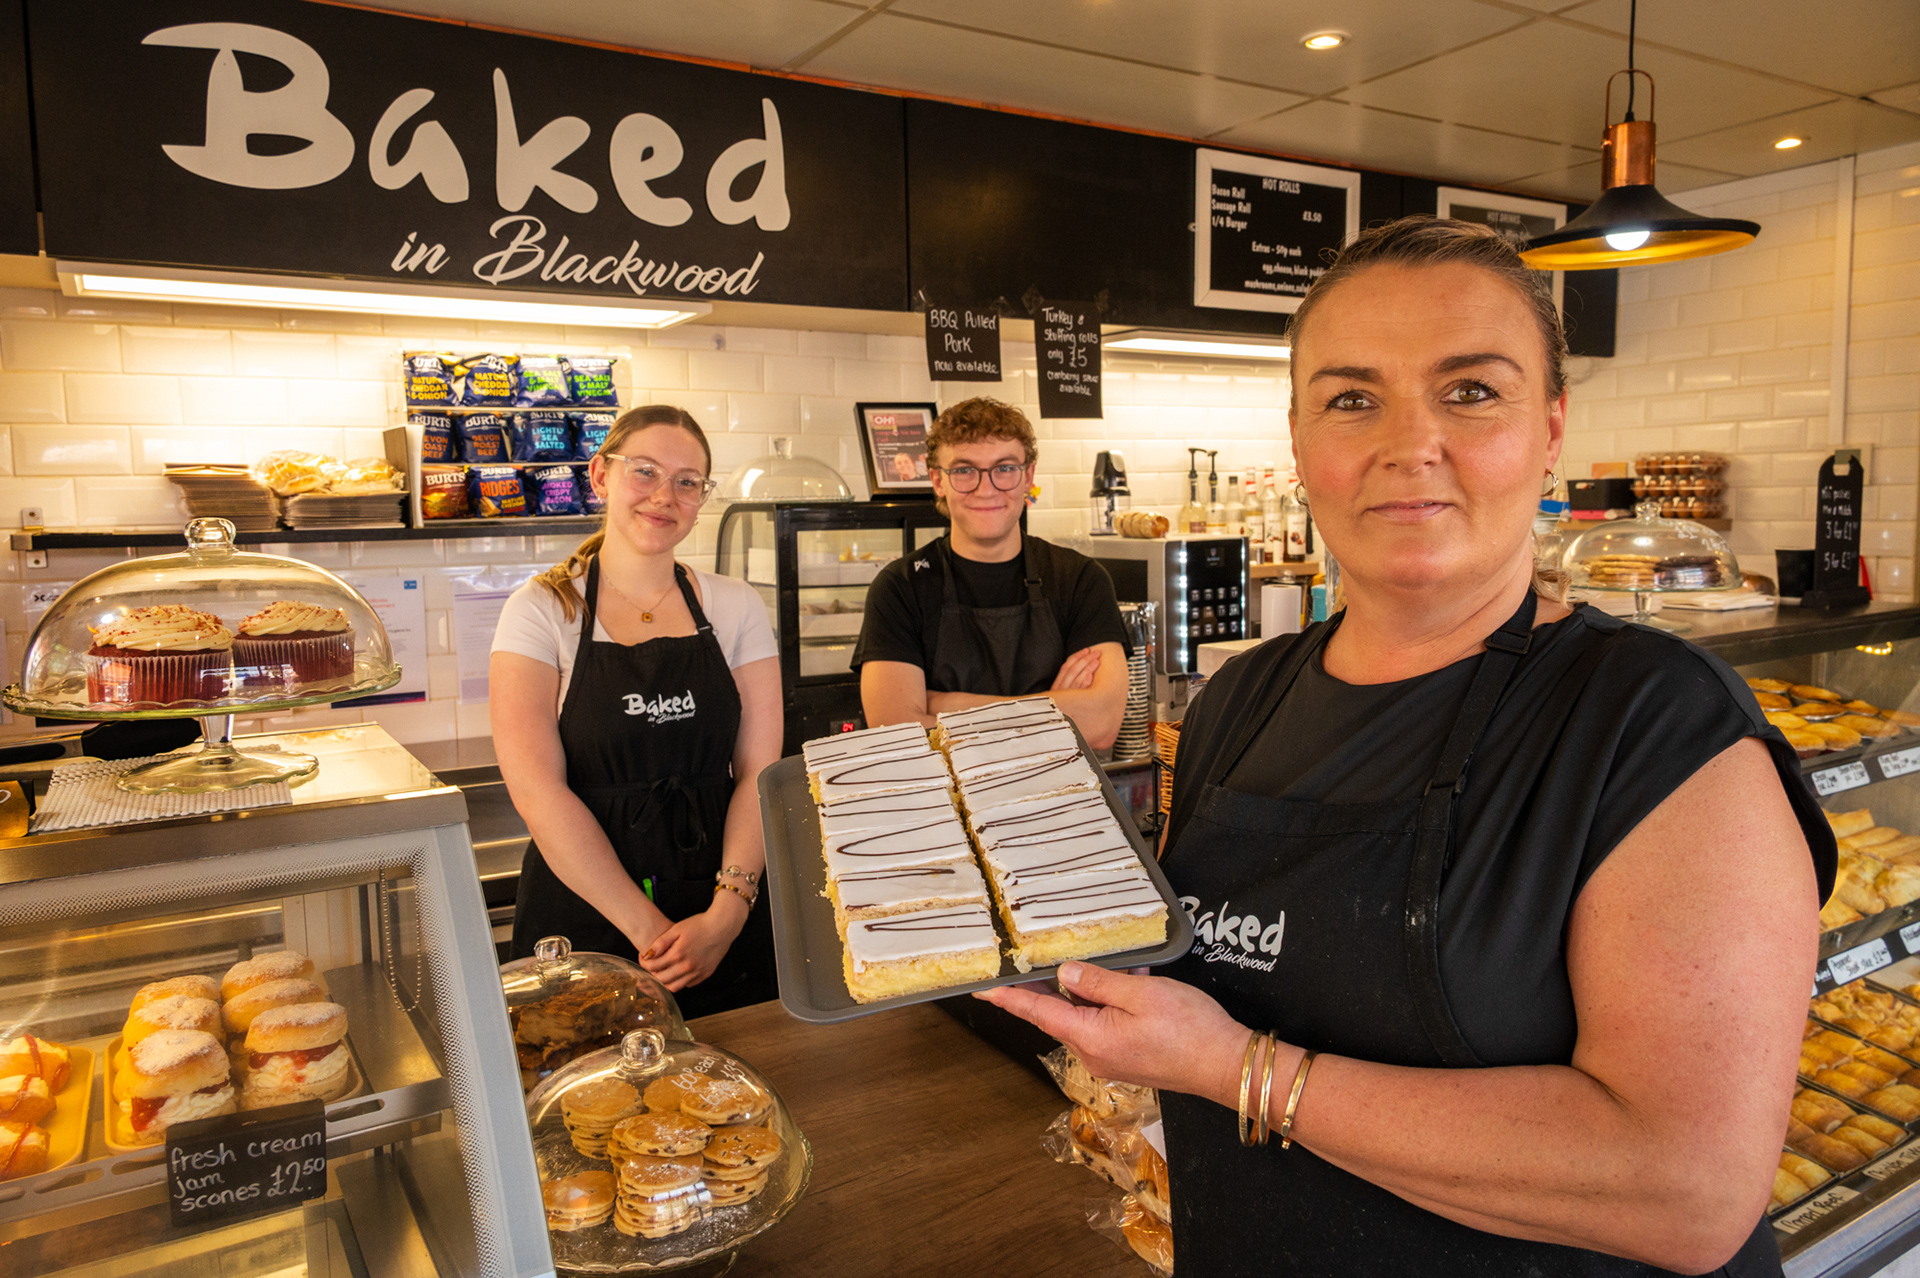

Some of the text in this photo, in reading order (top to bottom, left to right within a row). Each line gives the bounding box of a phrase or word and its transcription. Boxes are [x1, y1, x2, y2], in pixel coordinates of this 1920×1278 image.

[141, 22, 791, 231] Baked
[1231, 186, 1246, 199] Roll
[1262, 178, 1300, 194] HOT ROLLS
[1238, 201, 1252, 214] Roll
[391, 215, 765, 296] in Blackwood
[930, 309, 997, 330] BBQ Pulled
[1041, 306, 1073, 331] Turkey
[944, 333, 973, 353] Pork
[1044, 327, 1099, 349] Stuffing rolls
[934, 360, 1000, 374] now available
[1047, 347, 1088, 368] only £5
[424, 435, 448, 444] EVON
[585, 430, 609, 438] LIGHT
[424, 443, 447, 451] OAST
[425, 472, 466, 486] BURTS
[480, 479, 520, 497] RIDGES
[621, 689, 696, 716] Baked
[1191, 942, 1278, 973] in Blackwood
[170, 1131, 322, 1174] fresh cream
[173, 1172, 225, 1199] jam
[180, 1182, 261, 1213] scones
